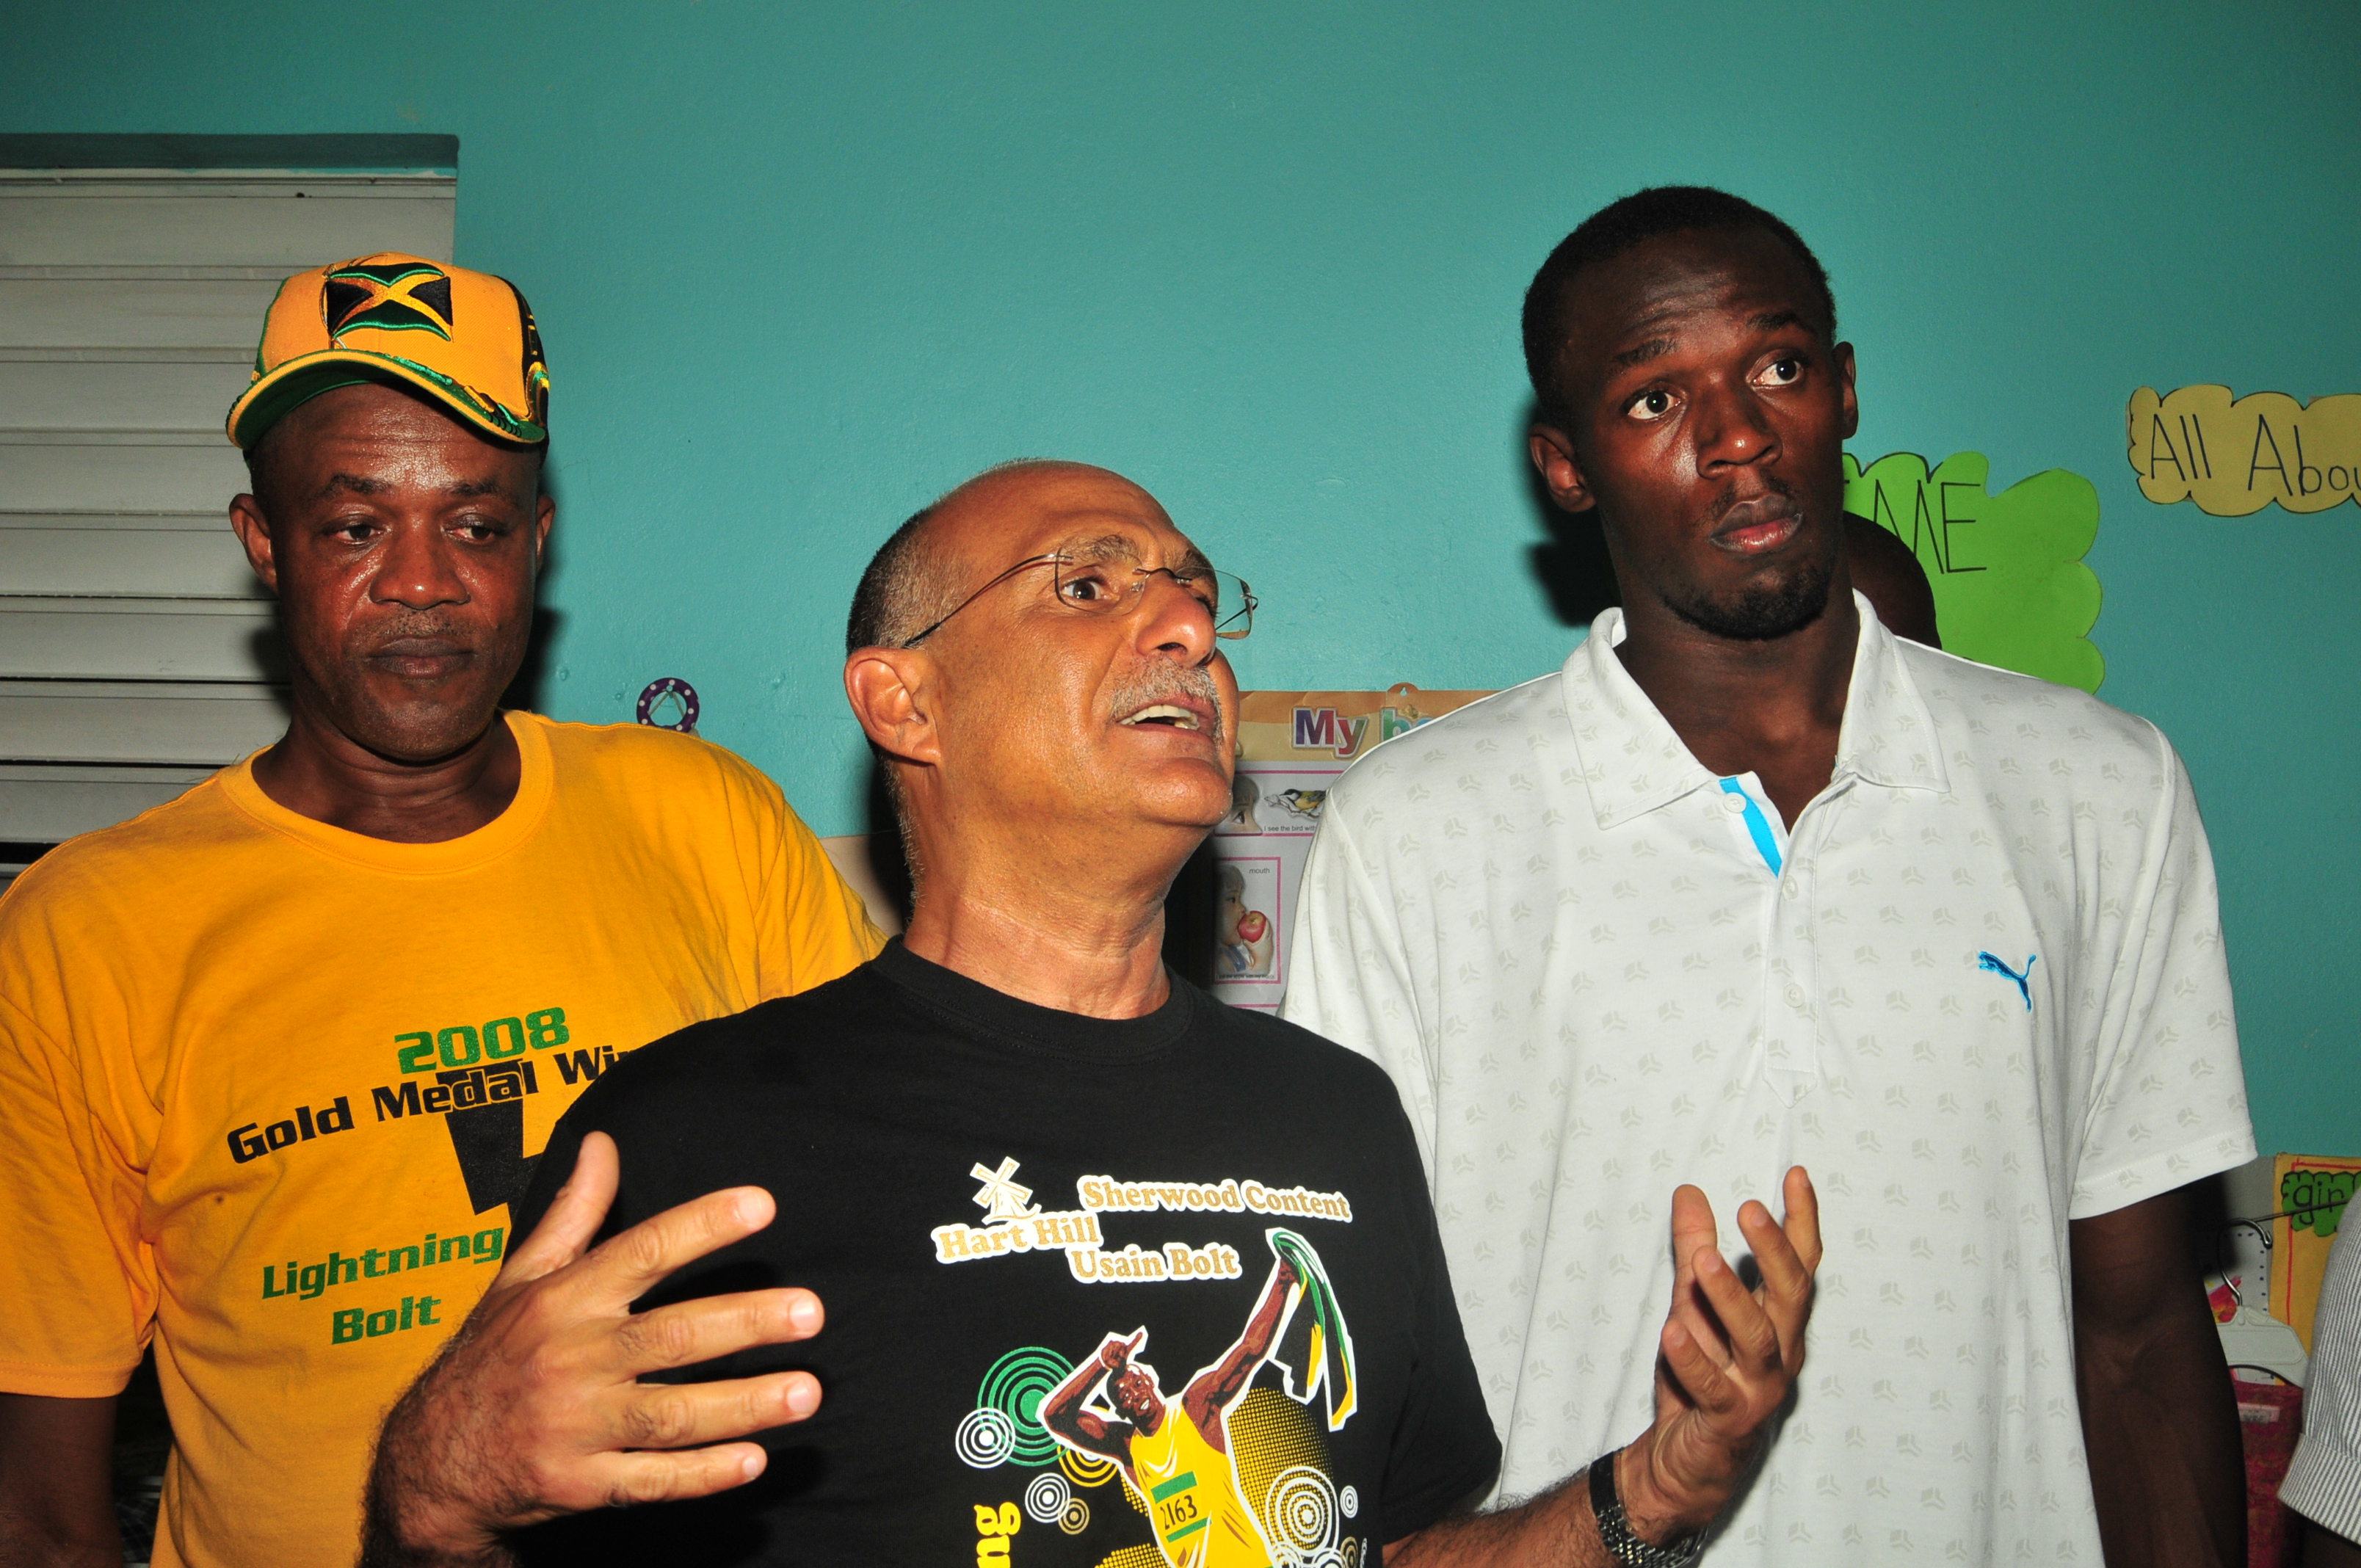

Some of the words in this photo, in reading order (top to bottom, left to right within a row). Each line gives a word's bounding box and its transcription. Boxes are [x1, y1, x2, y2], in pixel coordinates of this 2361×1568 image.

[2150, 413, 2211, 482] All
[1294, 708, 1368, 758] My
[1381, 708, 1435, 742] b
[394, 1006, 570, 1075] 2008
[227, 1096, 355, 1164] Gold
[371, 1060, 540, 1122] Medal
[1082, 1180, 1241, 1208] Sherwood
[1245, 1185, 1351, 1219] Content
[937, 1224, 1028, 1258] Hart
[1031, 1216, 1100, 1245] Hill
[261, 1227, 504, 1301] Lightning
[1070, 1249, 1164, 1278] Usain
[1168, 1248, 1238, 1276] Bolt
[331, 1295, 441, 1346] Bolt
[1160, 1494, 1197, 1531] 2163
